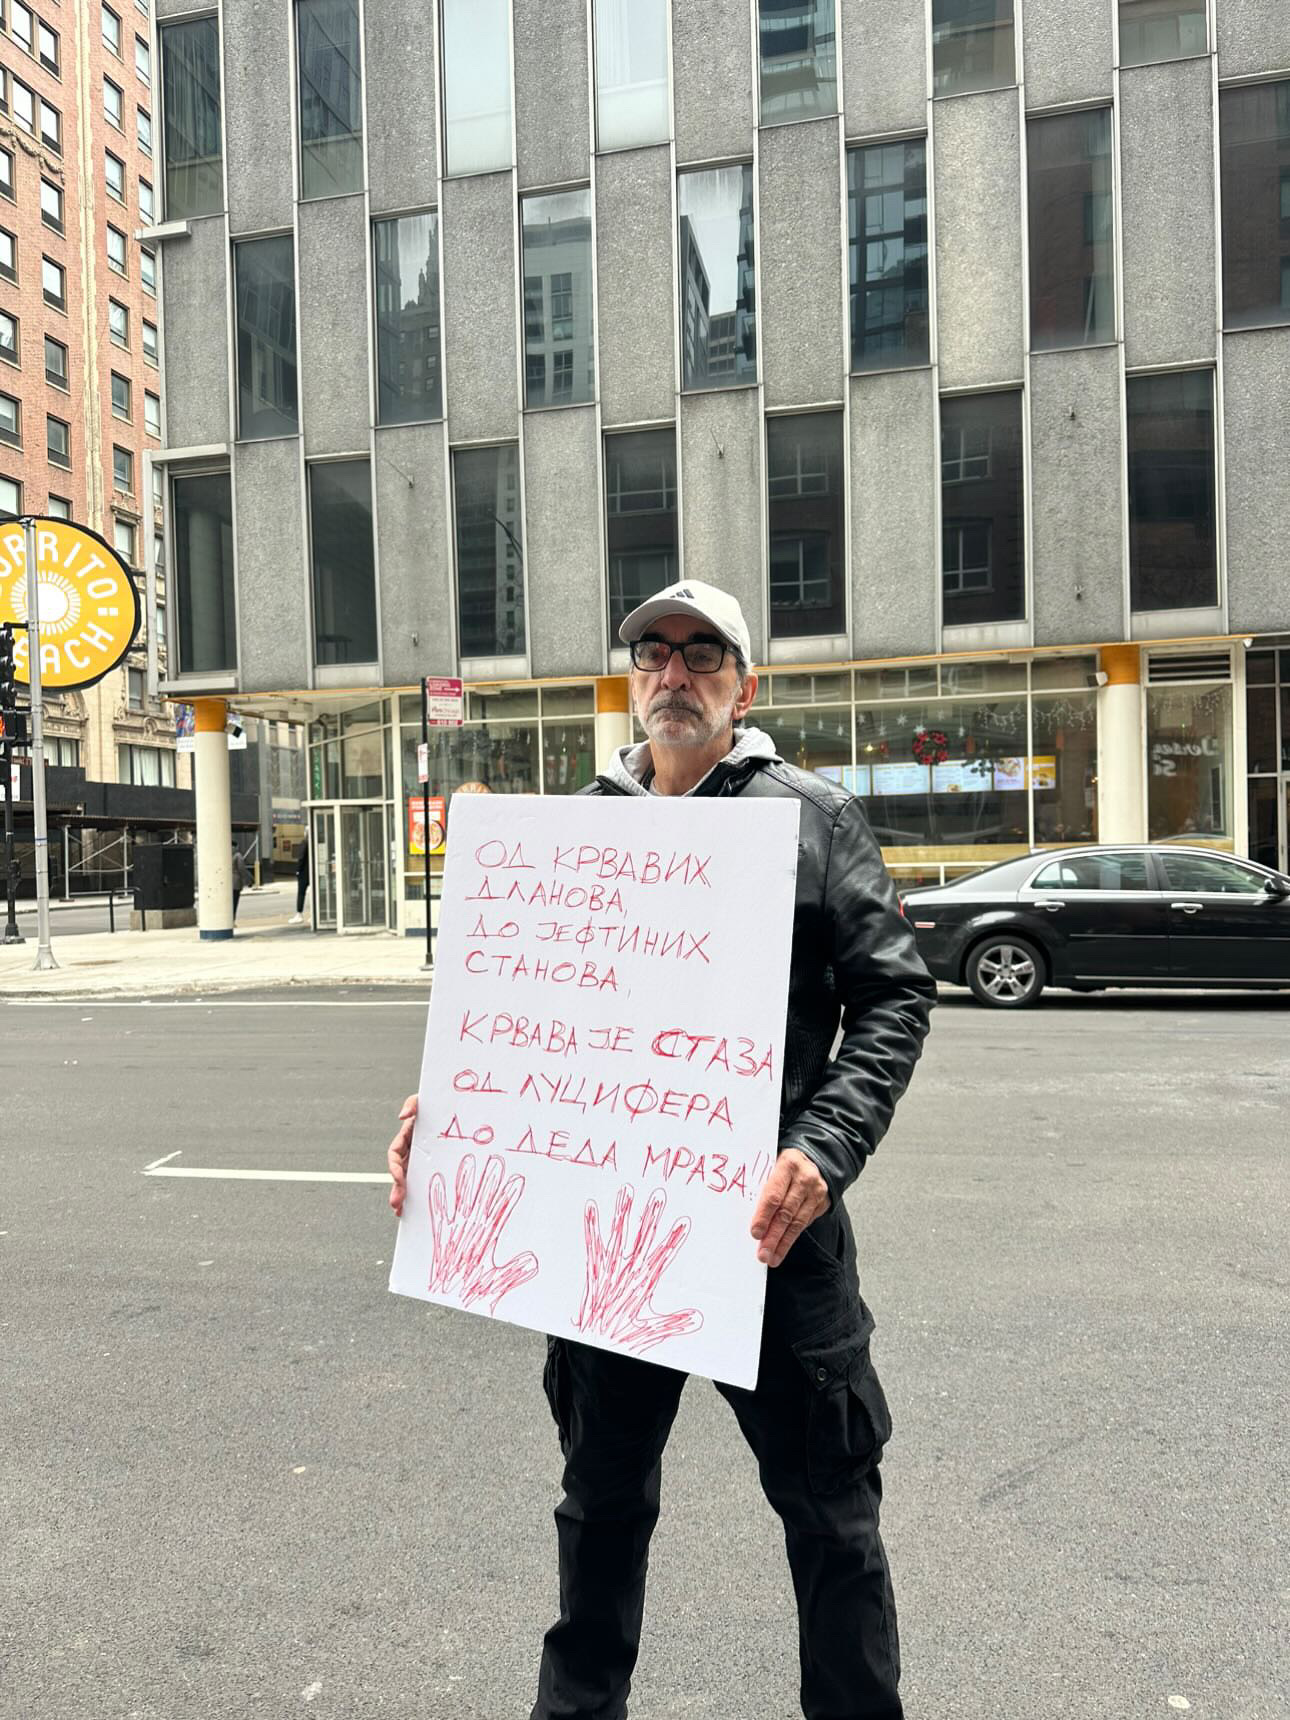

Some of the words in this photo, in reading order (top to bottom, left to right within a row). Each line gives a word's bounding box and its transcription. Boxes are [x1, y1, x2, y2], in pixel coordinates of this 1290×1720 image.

[13, 622, 115, 674] EACH
[475, 840, 536, 869] ОД
[553, 845, 712, 888] КРВАВИХ
[464, 876, 627, 918] ДЛАНОВА,
[466, 913, 519, 938] ДО
[536, 915, 711, 964] ЈЕФТИНИХ
[460, 1009, 578, 1056] КРВАВА
[588, 1026, 635, 1052] ЈЕ
[651, 1028, 774, 1082] СТАЗА
[452, 1068, 508, 1094] ОД
[519, 1072, 733, 1131] ЛУЦИФЕРА
[437, 1113, 494, 1145] ДО
[505, 1124, 617, 1172] ДЕДА
